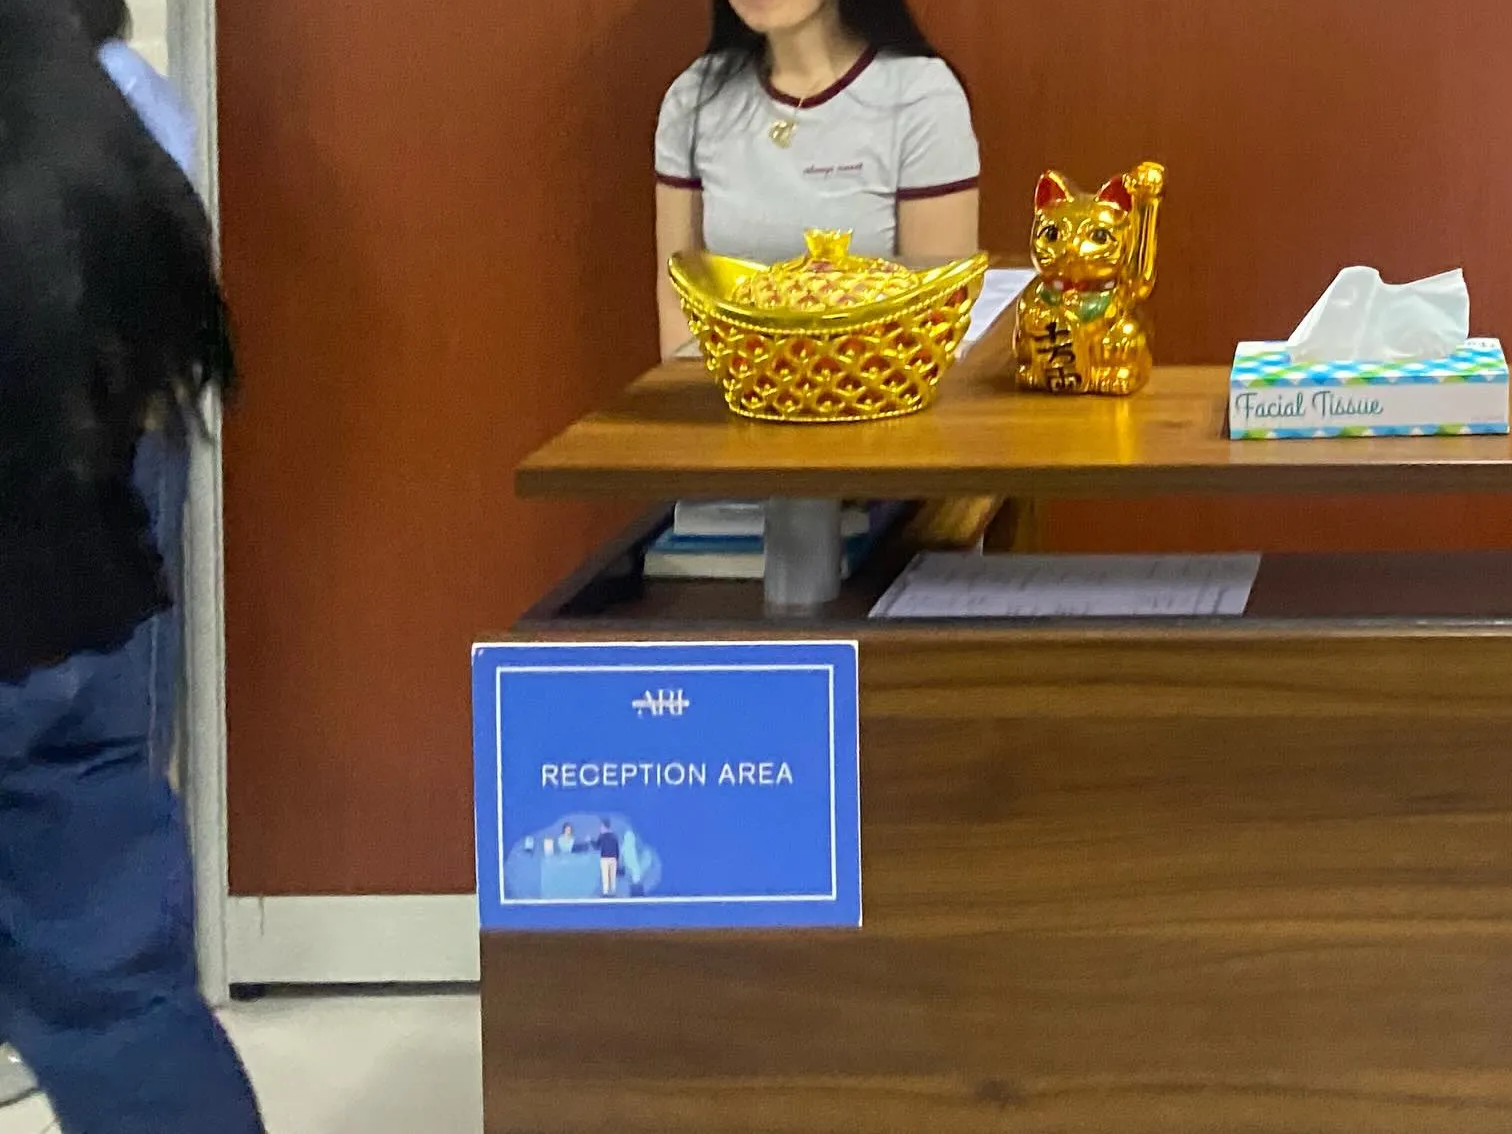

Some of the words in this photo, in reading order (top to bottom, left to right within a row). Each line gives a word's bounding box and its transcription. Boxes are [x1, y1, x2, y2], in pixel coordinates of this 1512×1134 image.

[1235, 392, 1306, 421] Facial
[1311, 390, 1384, 418] Tissue
[541, 763, 707, 788] RECEPTION
[718, 762, 794, 786] AREA
